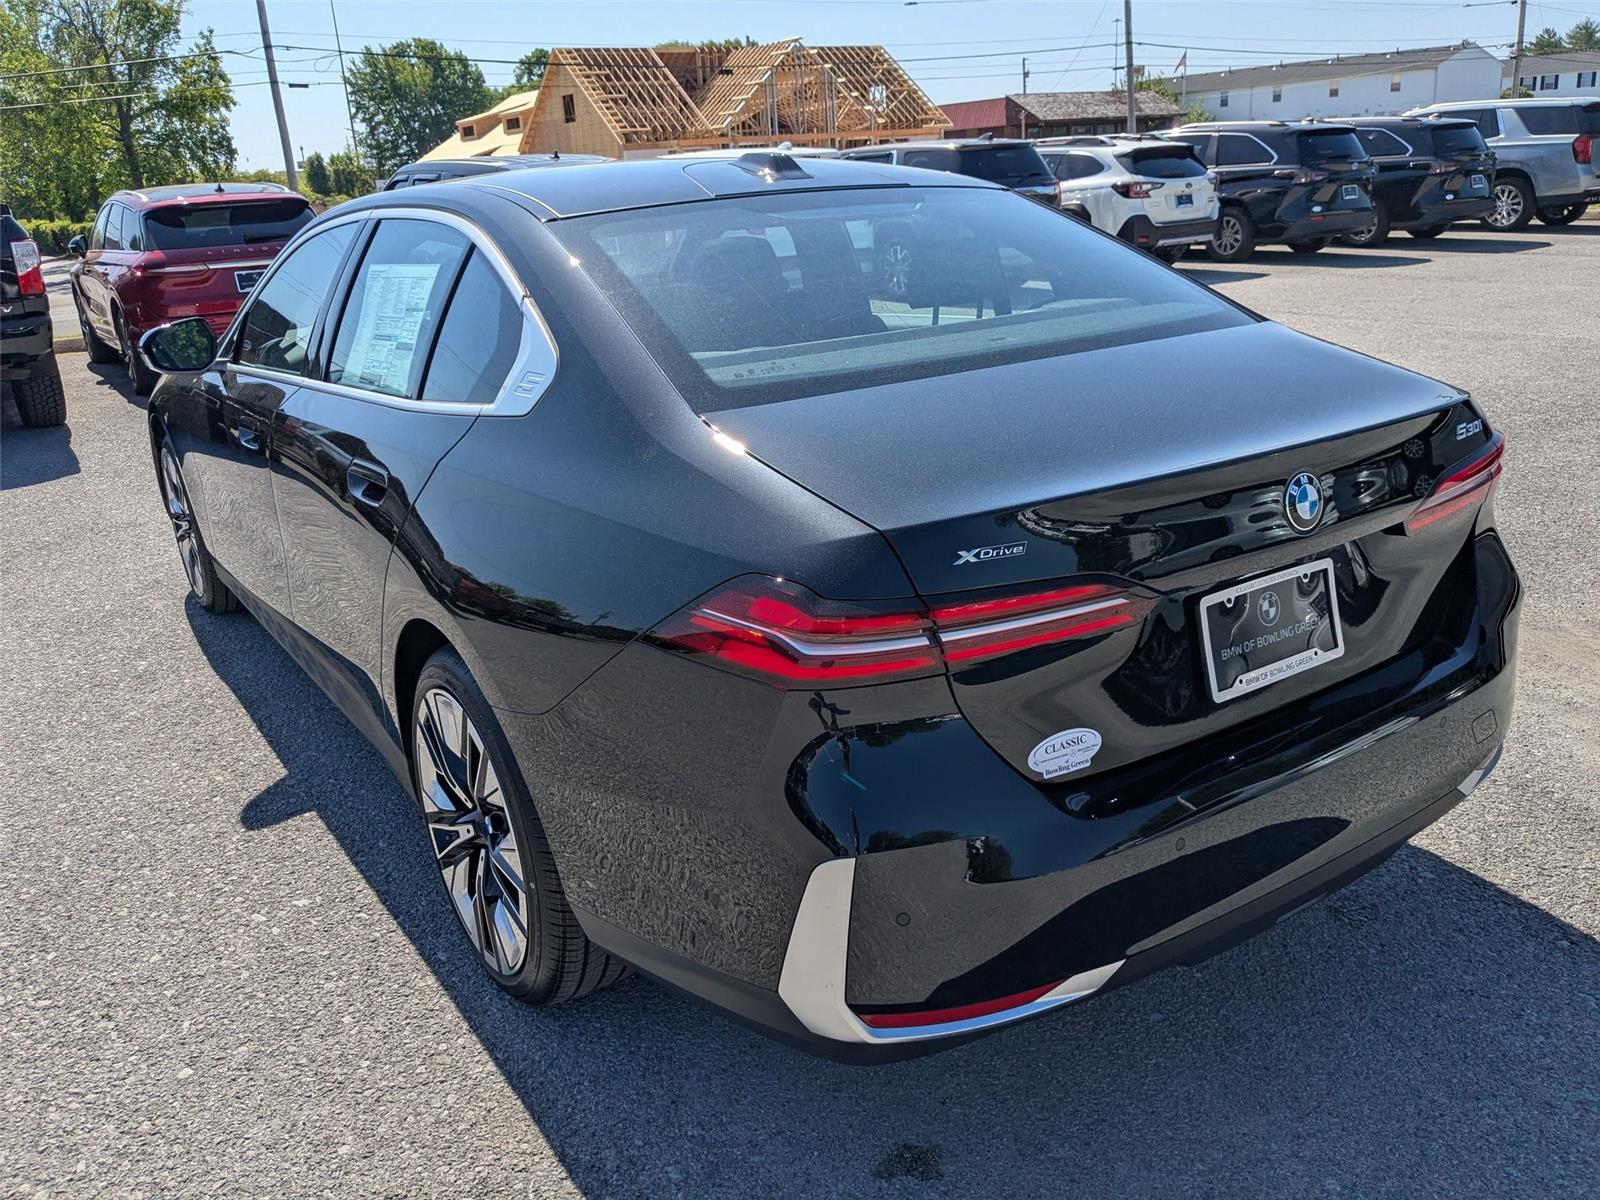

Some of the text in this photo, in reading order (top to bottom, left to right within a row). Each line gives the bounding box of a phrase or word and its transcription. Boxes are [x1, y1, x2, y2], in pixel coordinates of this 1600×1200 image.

[207, 245, 283, 255] LINCOL
[1221, 616, 1321, 660] BMW OF BOWLING GREEN
[1245, 655, 1314, 686] BMW OF BOWLING GREEN
[1045, 734, 1087, 755] CLASSIC
[1045, 763, 1071, 776] Bowling
[1070, 758, 1090, 769] Green
